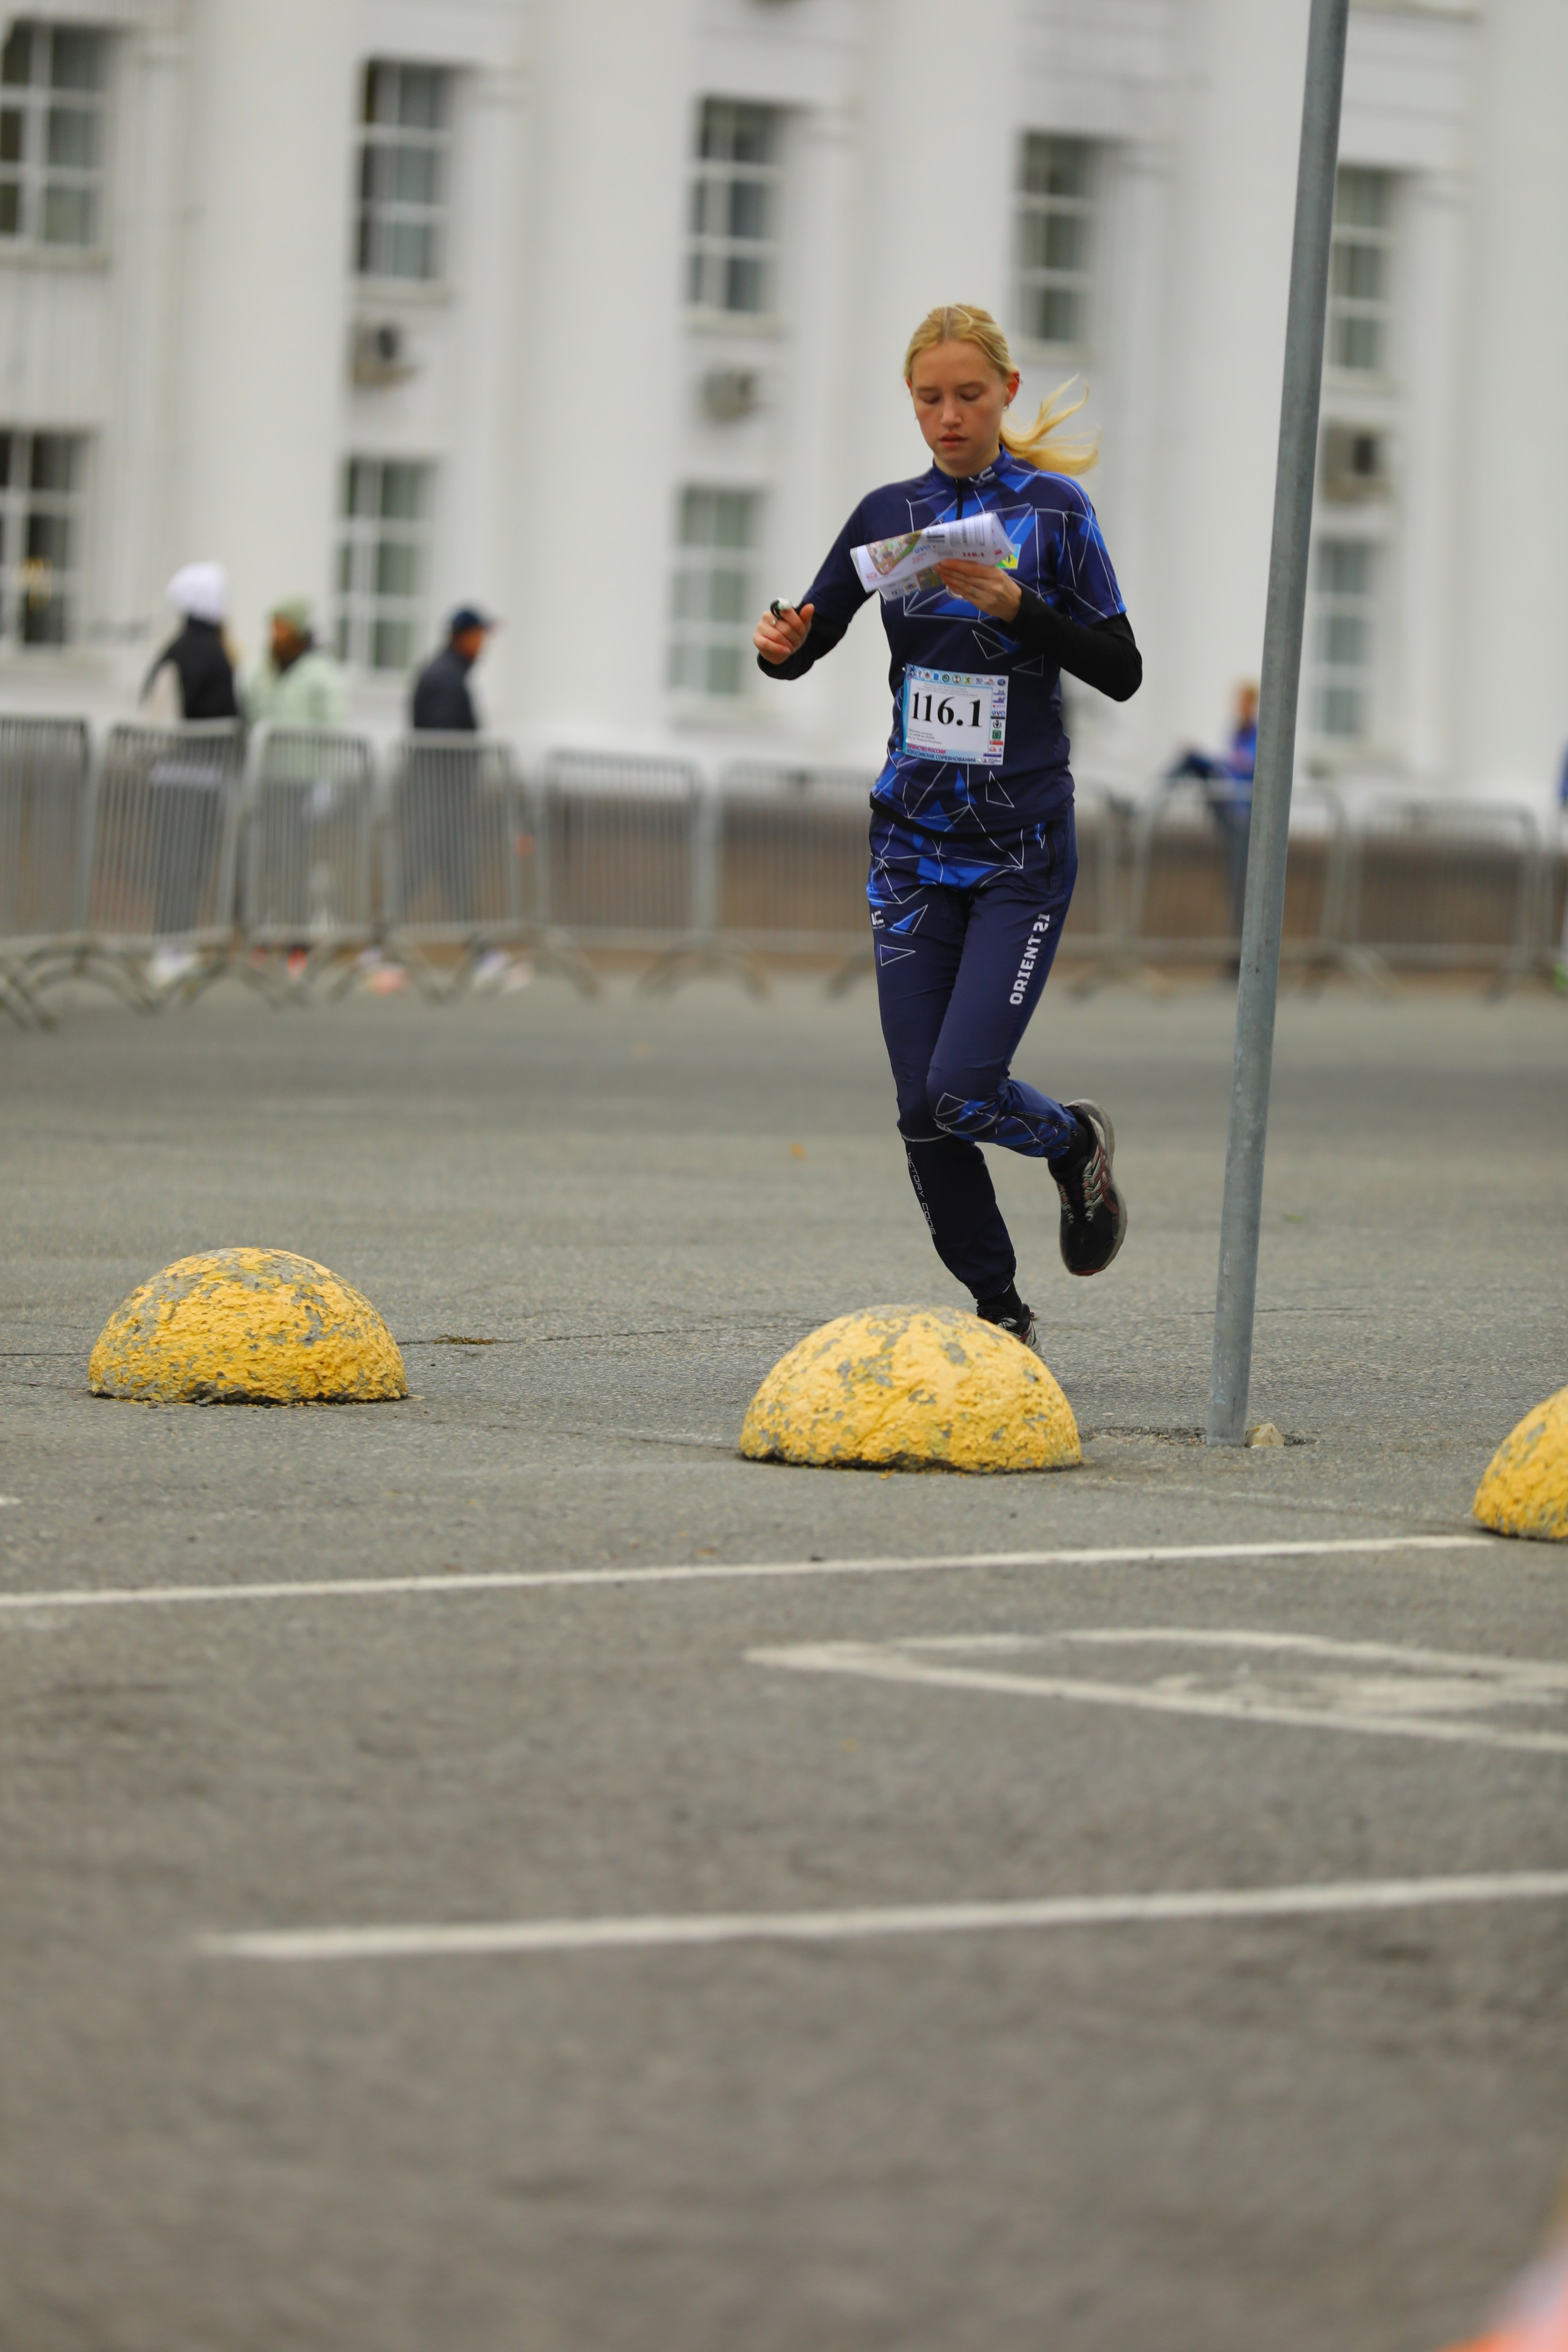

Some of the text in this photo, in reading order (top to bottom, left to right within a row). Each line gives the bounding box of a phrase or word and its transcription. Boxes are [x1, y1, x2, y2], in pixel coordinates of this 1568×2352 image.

[910, 692, 984, 728] 116.1
[935, 753, 976, 763] СОРЕВНОВАНИЯ
[1009, 913, 1050, 1006] ORIENT 21
[908, 1152, 937, 1235] VICTORY CODE
